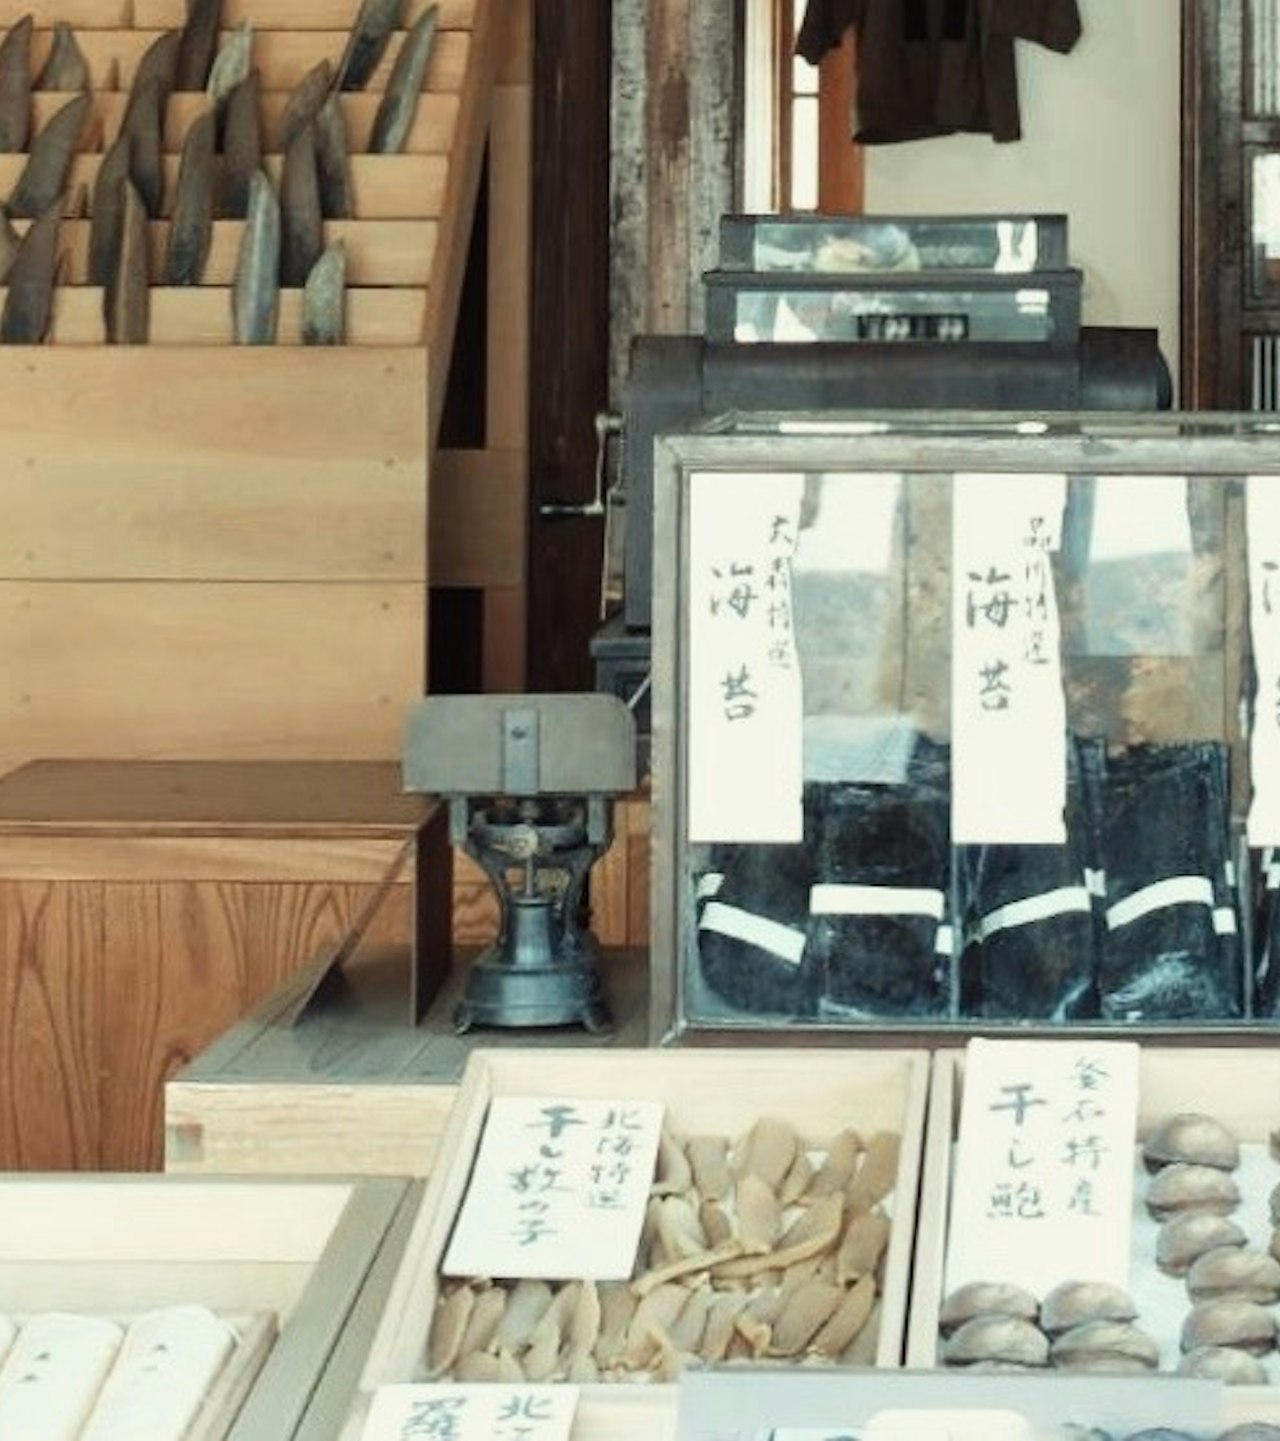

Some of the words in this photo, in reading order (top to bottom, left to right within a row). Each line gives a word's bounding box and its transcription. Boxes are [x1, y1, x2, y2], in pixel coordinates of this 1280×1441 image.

[966, 566, 1018, 712] 海苔
[506, 1105, 589, 1246] 干し数の子
[986, 1083, 1048, 1219] 干し鮑
